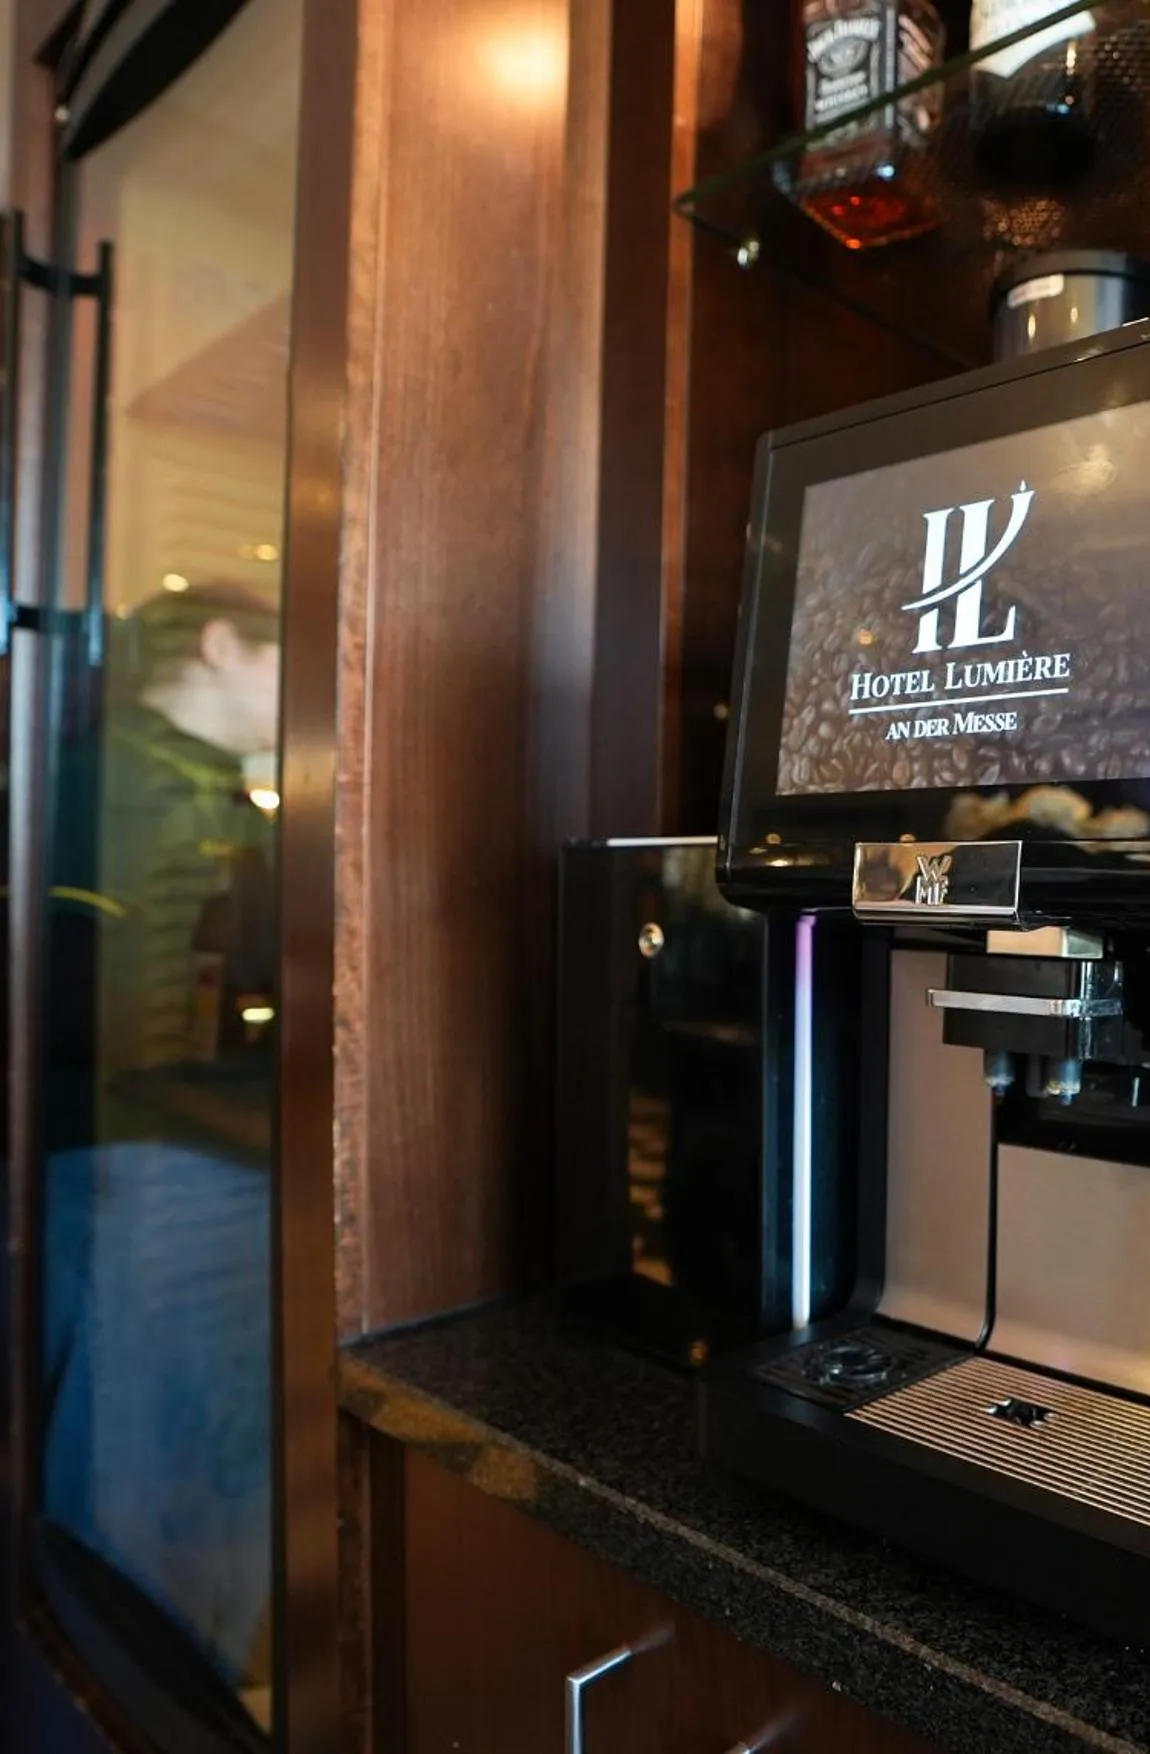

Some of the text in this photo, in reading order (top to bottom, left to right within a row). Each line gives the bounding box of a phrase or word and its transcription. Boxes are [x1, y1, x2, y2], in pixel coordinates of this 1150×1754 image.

[850, 650, 1071, 700] HOTEL LUMIÈRE
[885, 711, 1018, 741] AN DER MESSE
